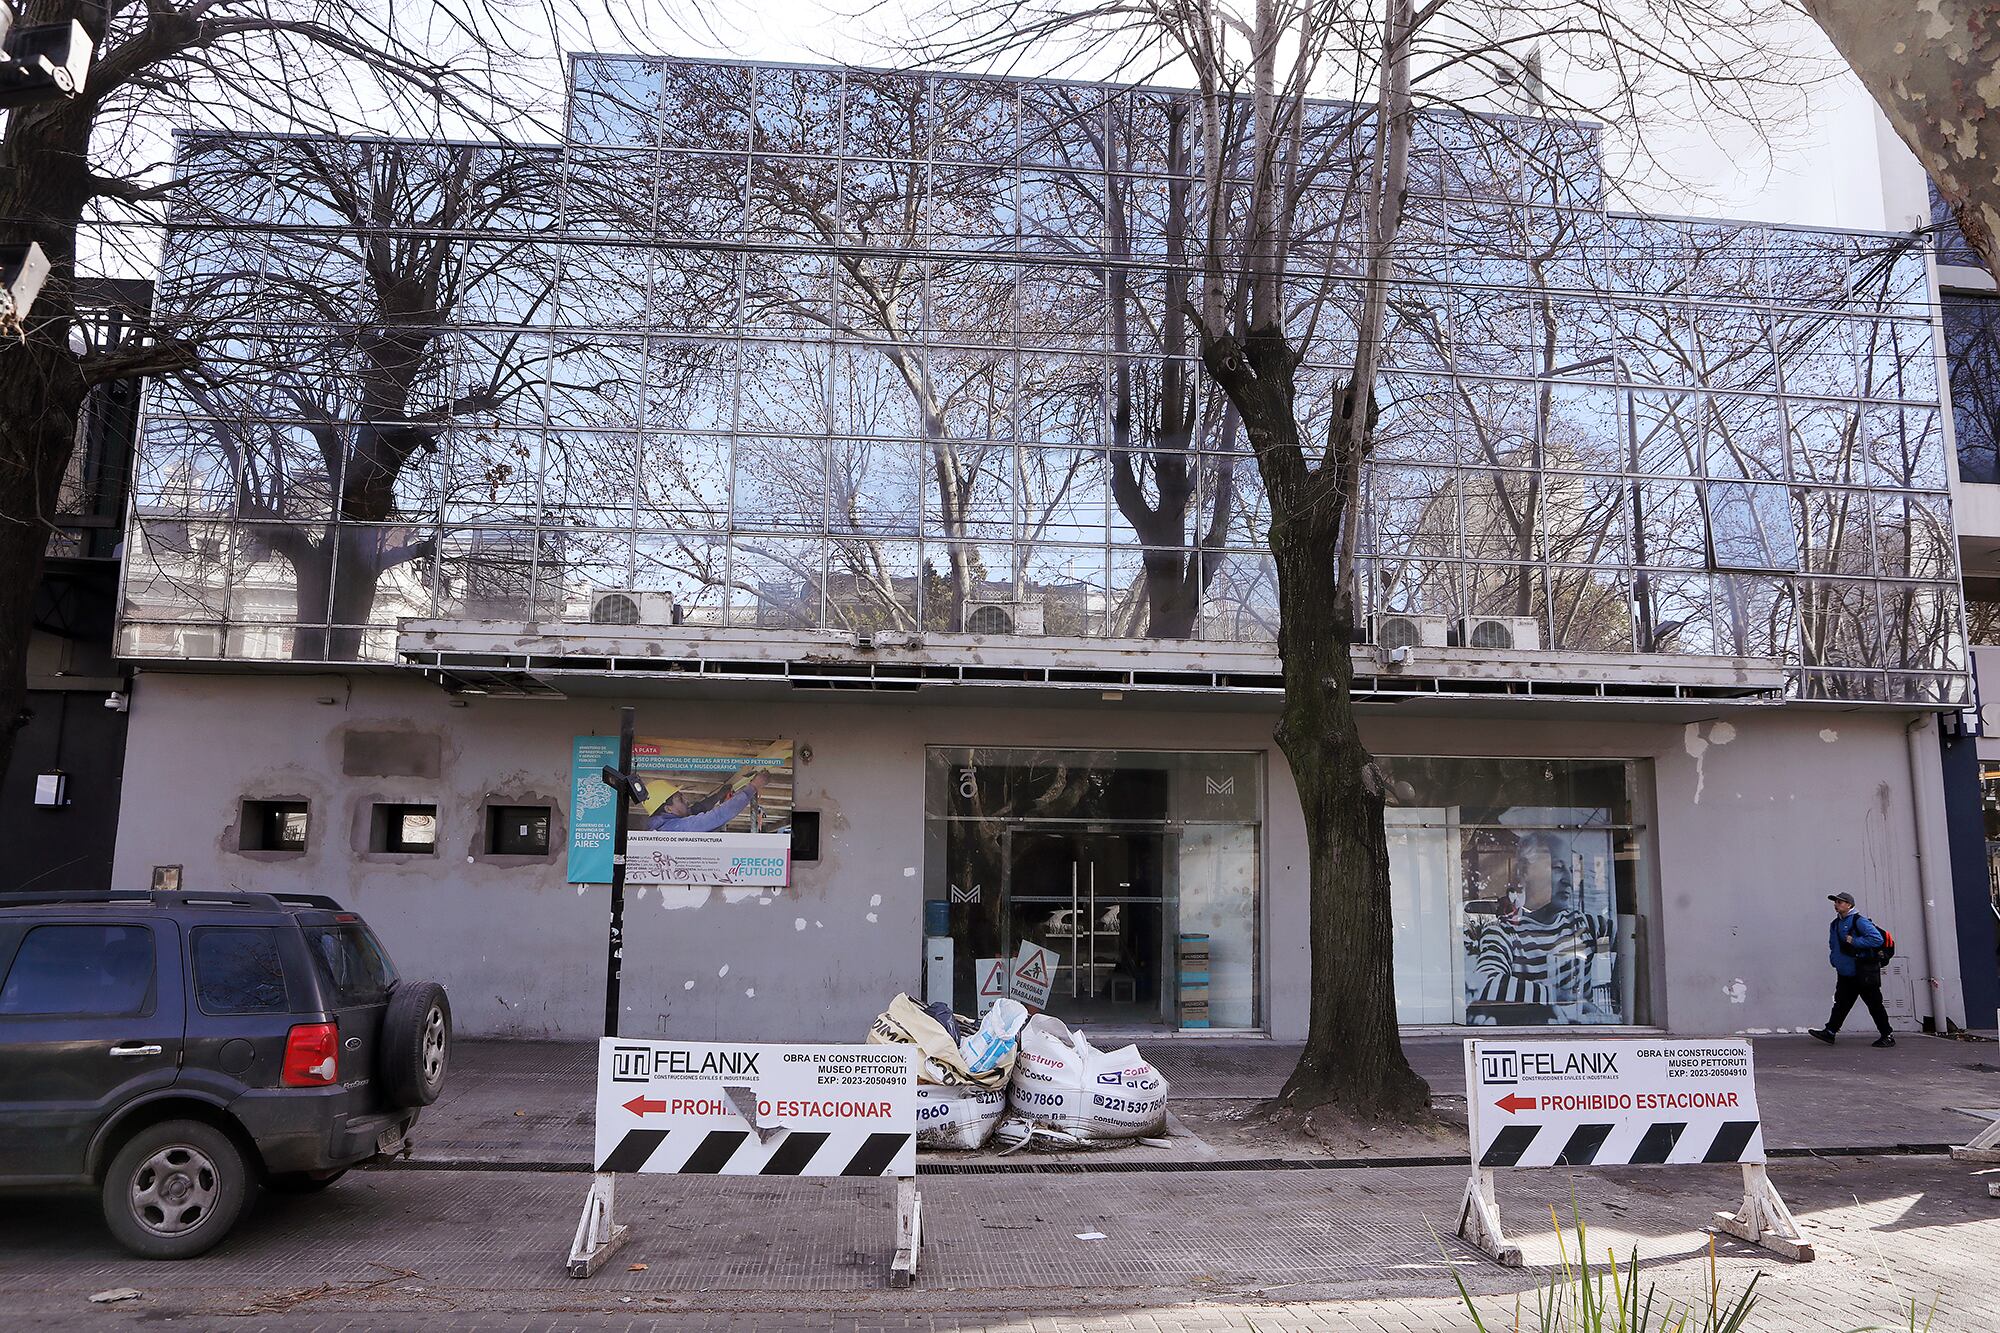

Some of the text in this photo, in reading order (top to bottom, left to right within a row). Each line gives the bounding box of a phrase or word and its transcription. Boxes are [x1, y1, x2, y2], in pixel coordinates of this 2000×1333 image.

[575, 832, 610, 840] BUENOS
[574, 840, 600, 848] AIRES
[732, 857, 784, 867] DERECHO
[739, 867, 782, 877] FUTURO
[1016, 980, 1044, 996] PERSONAS
[1011, 987, 1045, 1006] TRABAJANDO
[1636, 1048, 1747, 1058] OBRA EN CONSTRUCCION:
[654, 1050, 760, 1075] FELANIX
[783, 1054, 907, 1063] OBRA EN CONSTRUCCION:
[1521, 1053, 1619, 1074] FELANIX
[1668, 1058, 1747, 1067] MUSEO PETTORUTI
[818, 1065, 907, 1074] MUSEO PETTORUTI
[1668, 1069, 1747, 1077] EXP: 2023-20504910
[1025, 1068, 1053, 1082] Costo
[817, 1076, 907, 1085] EXP: 2023-20504910
[1126, 1080, 1138, 1089] al
[1016, 1087, 1032, 1103] 539
[1034, 1093, 1064, 1106] 7860
[1541, 1092, 1739, 1111] PROHIBIDO ESTACIONAR
[776, 1101, 892, 1117] ESTACIONAR
[1104, 1097, 1125, 1111] 221
[1127, 1101, 1148, 1113] 539
